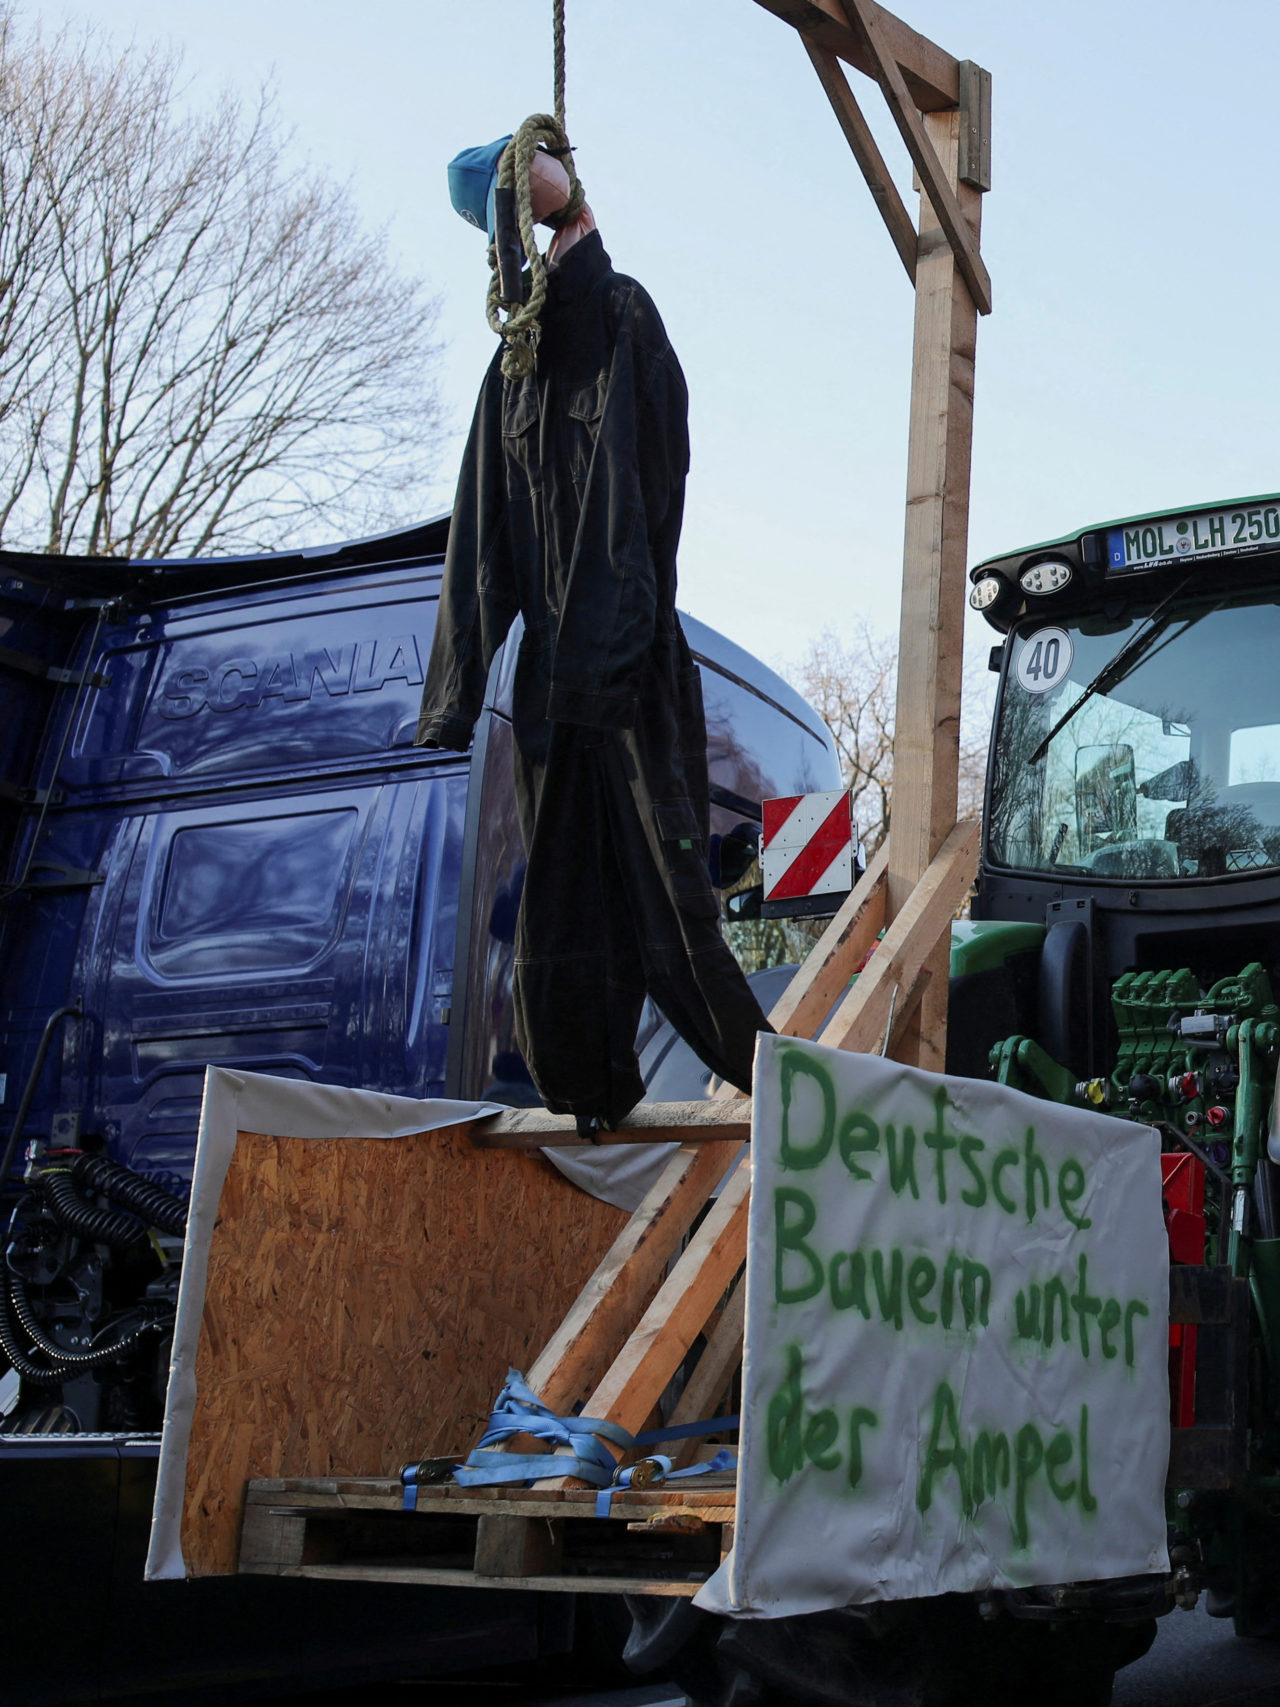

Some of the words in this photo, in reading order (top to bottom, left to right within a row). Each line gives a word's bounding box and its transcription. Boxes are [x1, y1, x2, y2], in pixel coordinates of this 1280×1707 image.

[1114, 552, 1121, 562] D
[1124, 525, 1174, 562] MOL
[1193, 515, 1226, 551] LH
[1231, 507, 1280, 545] 250
[157, 634, 424, 720] SCANIA
[1026, 637, 1060, 681] 40
[780, 1048, 1091, 1231] Deutsche
[774, 1186, 991, 1331] Bauern
[1015, 1253, 1149, 1368] unter
[767, 1345, 878, 1488] der
[916, 1381, 1098, 1551] Ampel
